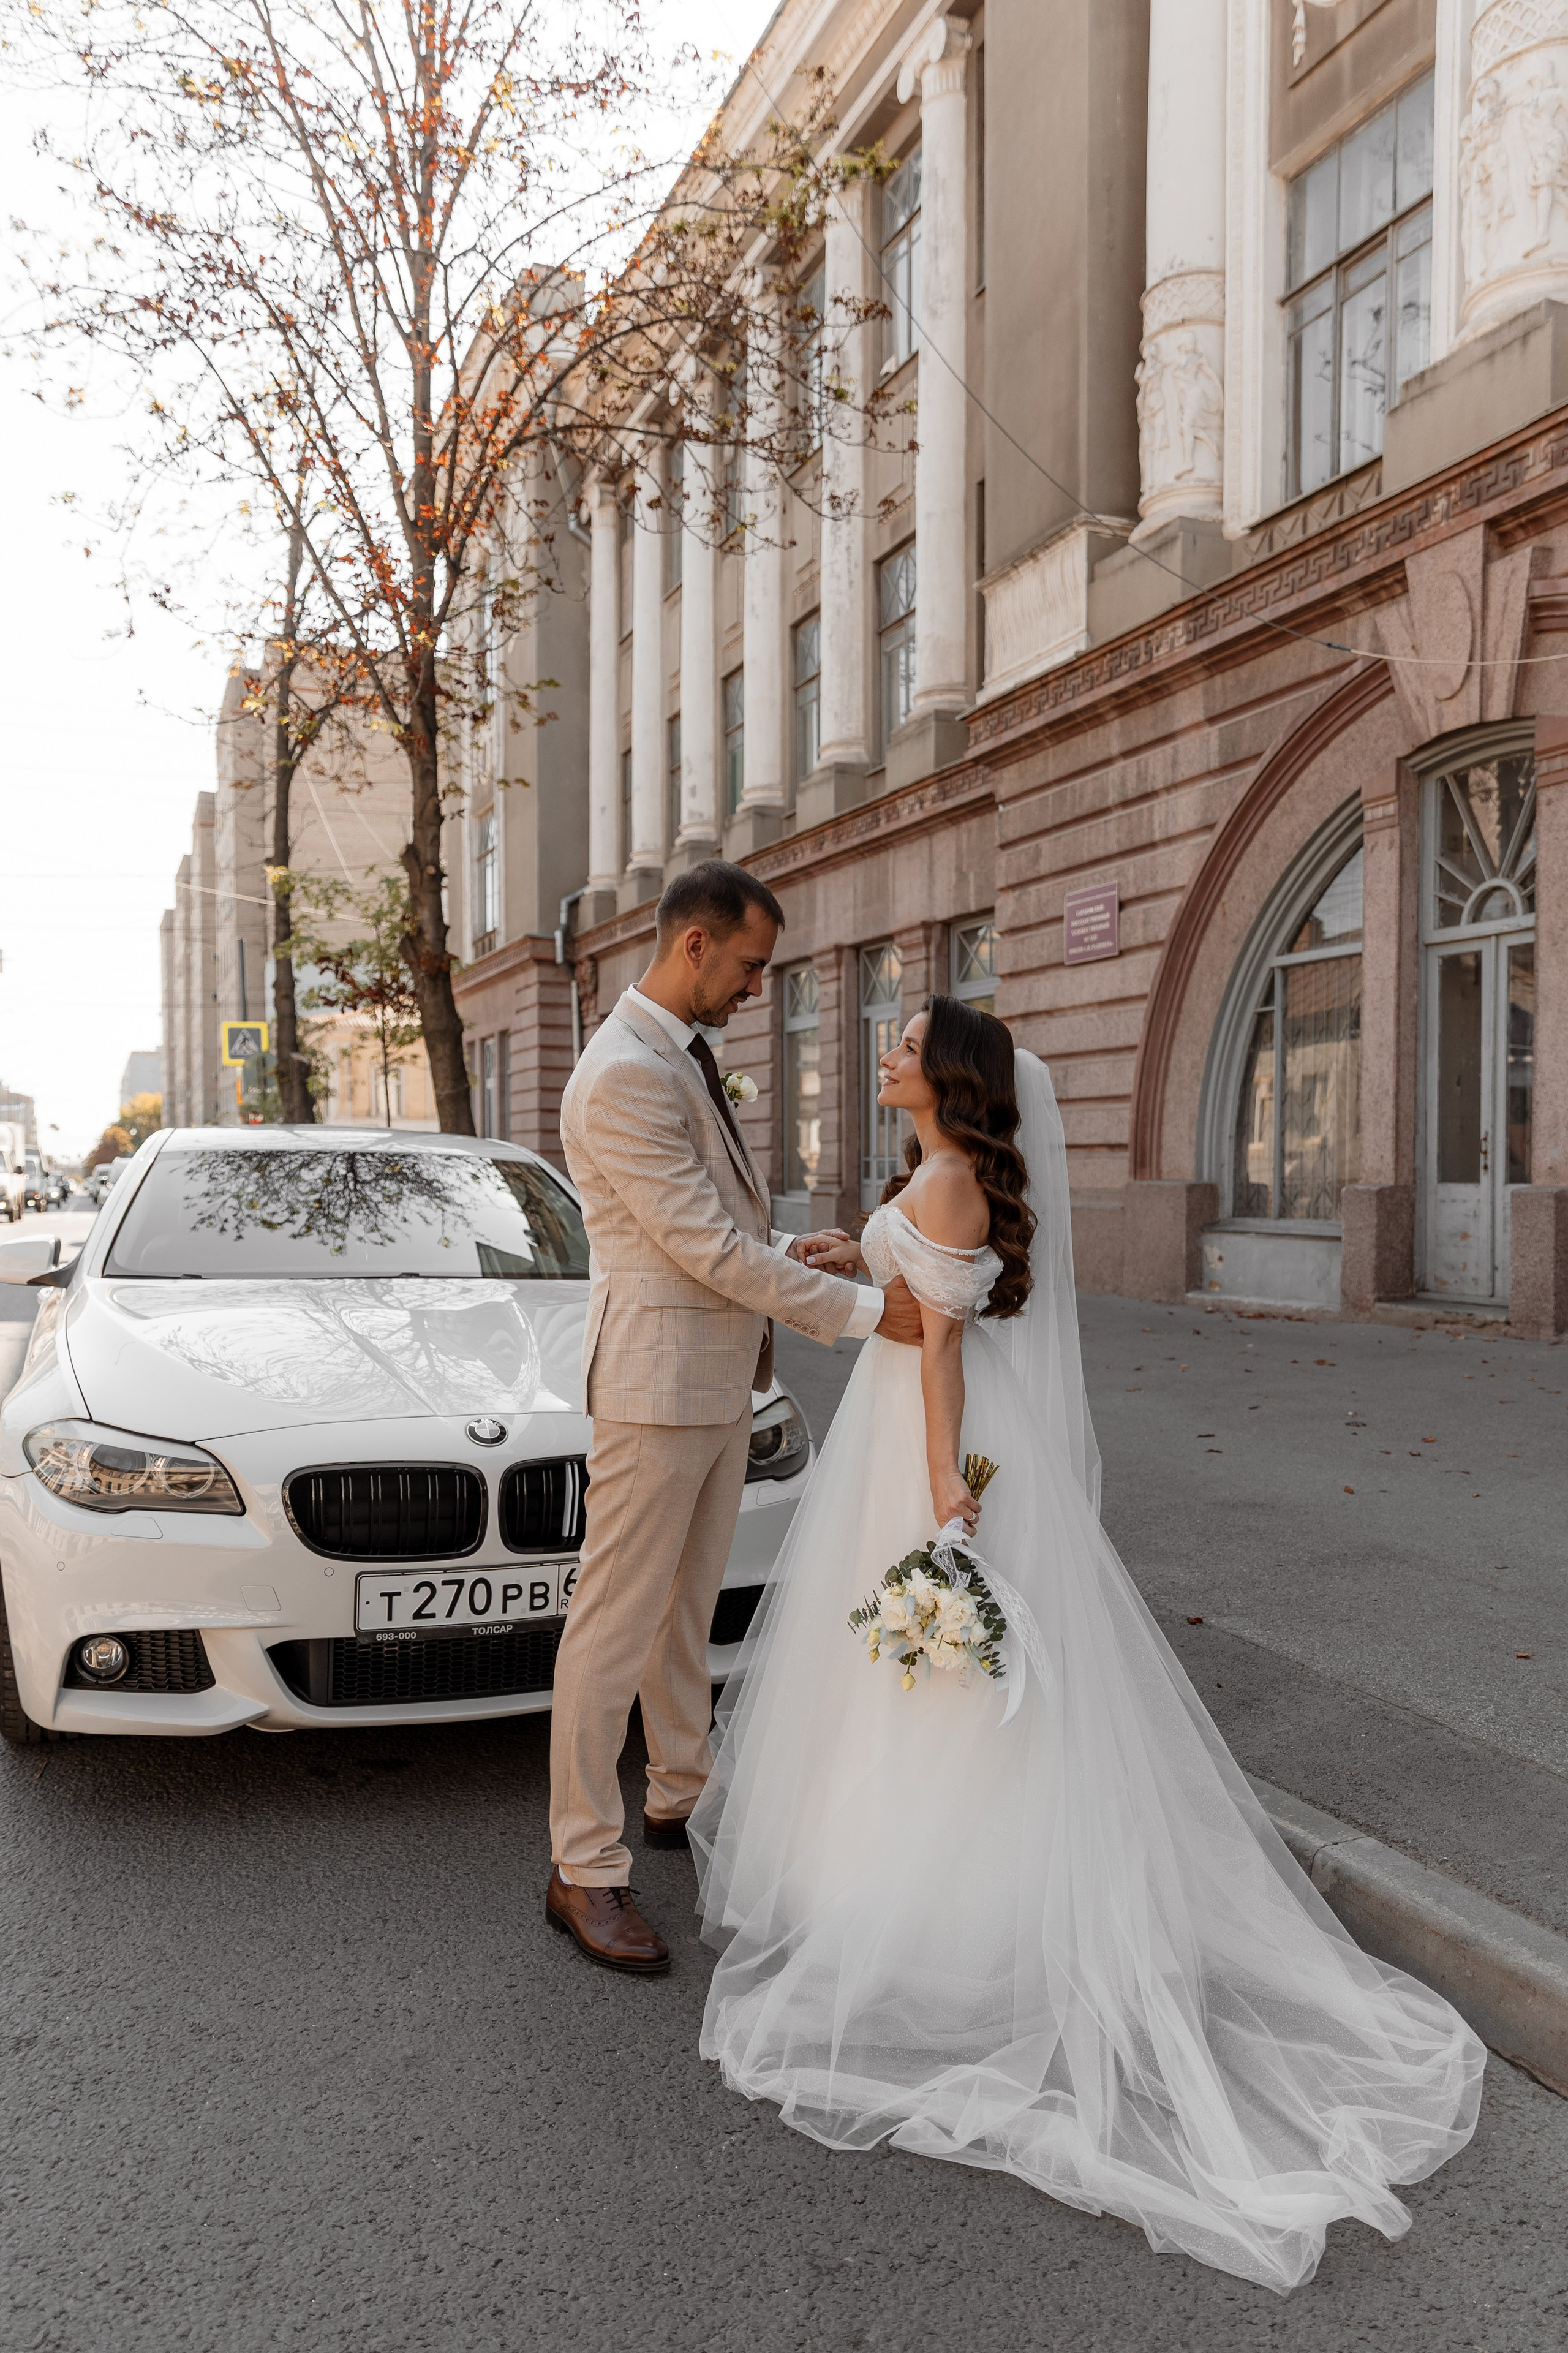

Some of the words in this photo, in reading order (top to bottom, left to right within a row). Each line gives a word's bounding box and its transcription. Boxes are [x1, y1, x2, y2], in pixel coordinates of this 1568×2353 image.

[470, 1418, 502, 1427] BMW
[563, 1568, 578, 1598] 6
[375, 1631, 417, 1641] 693-000
[472, 1625, 513, 1636] ТОЛСАР
